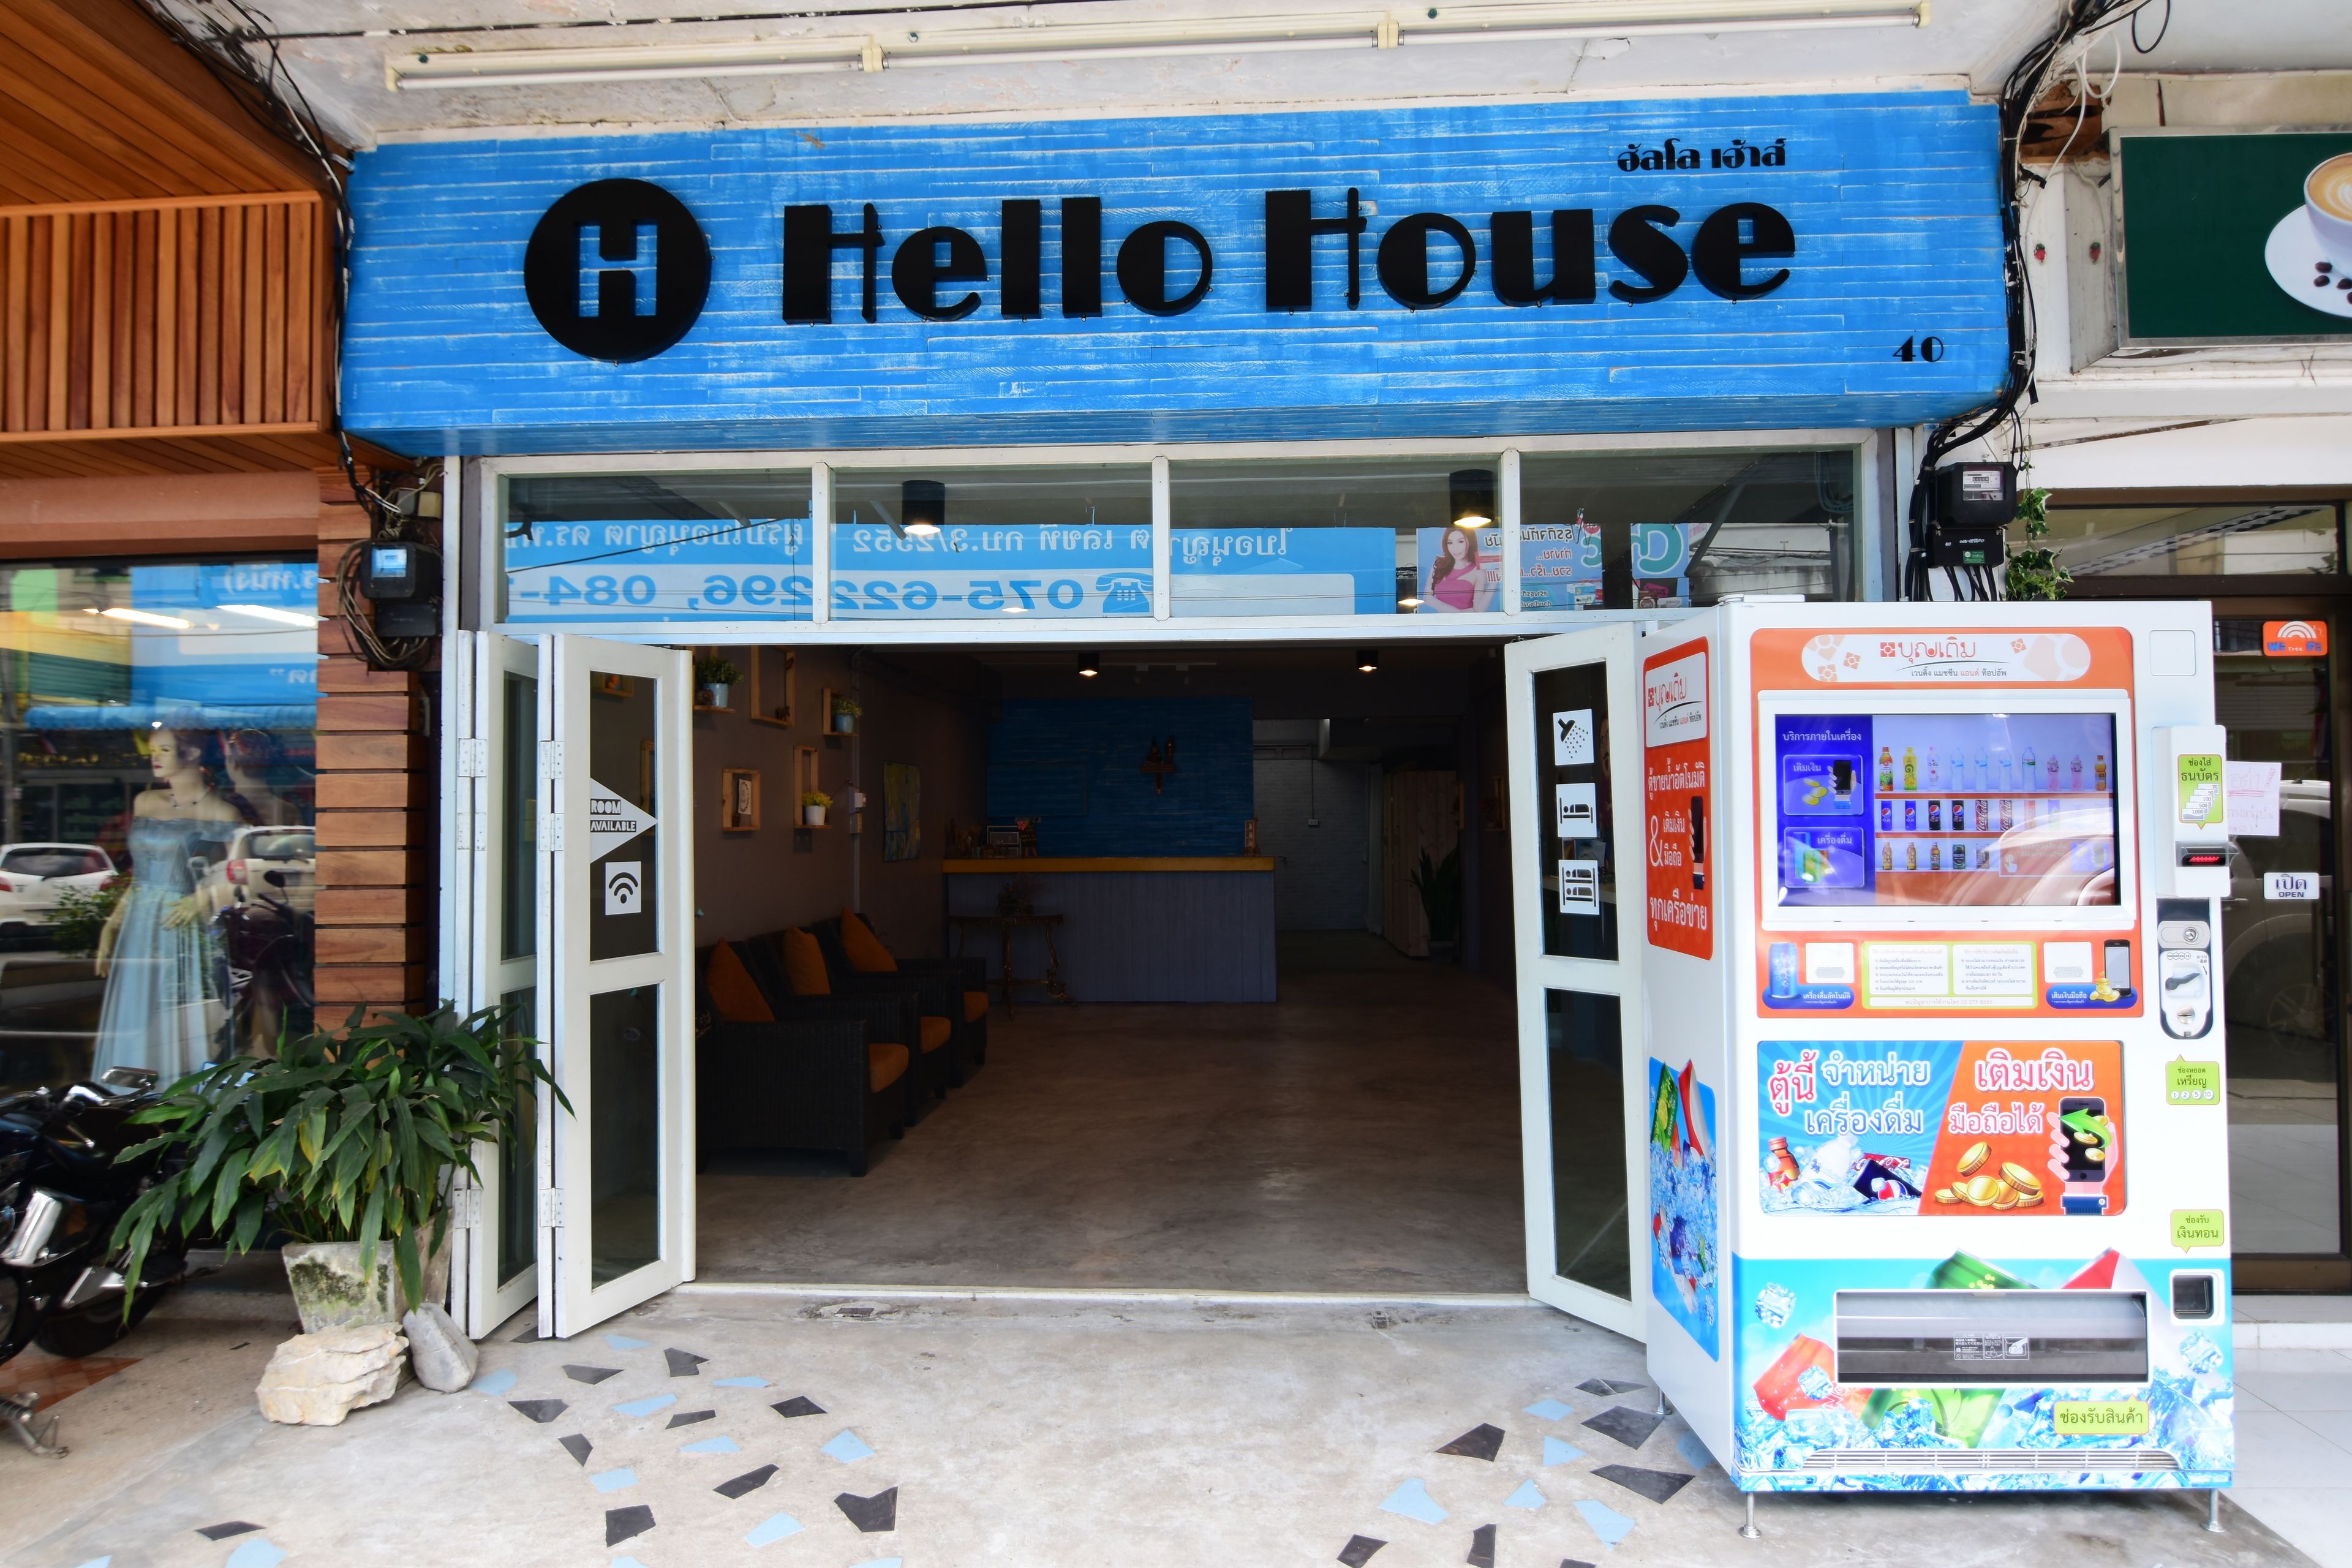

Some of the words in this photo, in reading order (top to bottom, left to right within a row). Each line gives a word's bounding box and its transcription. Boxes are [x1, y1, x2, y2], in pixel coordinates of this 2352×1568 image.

[783, 197, 1213, 325] Hello
[1265, 187, 1795, 313] House
[1894, 337, 1939, 362] 40
[2267, 641, 2286, 652] Wi
[2306, 641, 2321, 652] Fi
[1782, 728, 1862, 742] บริการภายในเครื่อง
[1793, 762, 1822, 772] เติมเงิน
[2188, 757, 2212, 767] ช่องใส่
[1648, 758, 1705, 800] ตู้ขายน้ำอัตโนมัติ
[2181, 768, 2218, 782] ธนบัตร
[590, 799, 621, 814] ROOM
[590, 821, 636, 832] AVAILABLE
[1663, 810, 1686, 835] เติมเงิน
[1817, 832, 1853, 845] เครื่องดื่ม
[1664, 842, 1681, 867] มือถือ
[2275, 873, 2307, 889] เปิด
[1649, 888, 1708, 932] ทุกเครือข่าย
[1822, 1050, 1930, 1086] จำหน่าย
[1975, 1048, 2093, 1091] เติมเงิน
[1769, 1050, 1818, 1116] ตู้นี้
[2177, 1074, 2207, 1088] เหรียญ
[1805, 1091, 1923, 1134] เครื่องดื่ม
[1948, 1102, 2045, 1134] มือถือได้
[2185, 1215, 2209, 1224] ช่องรับ
[2177, 1226, 2218, 1238] เงินทอน
[2060, 1407, 2143, 1424] ช่องรับสินค้า
